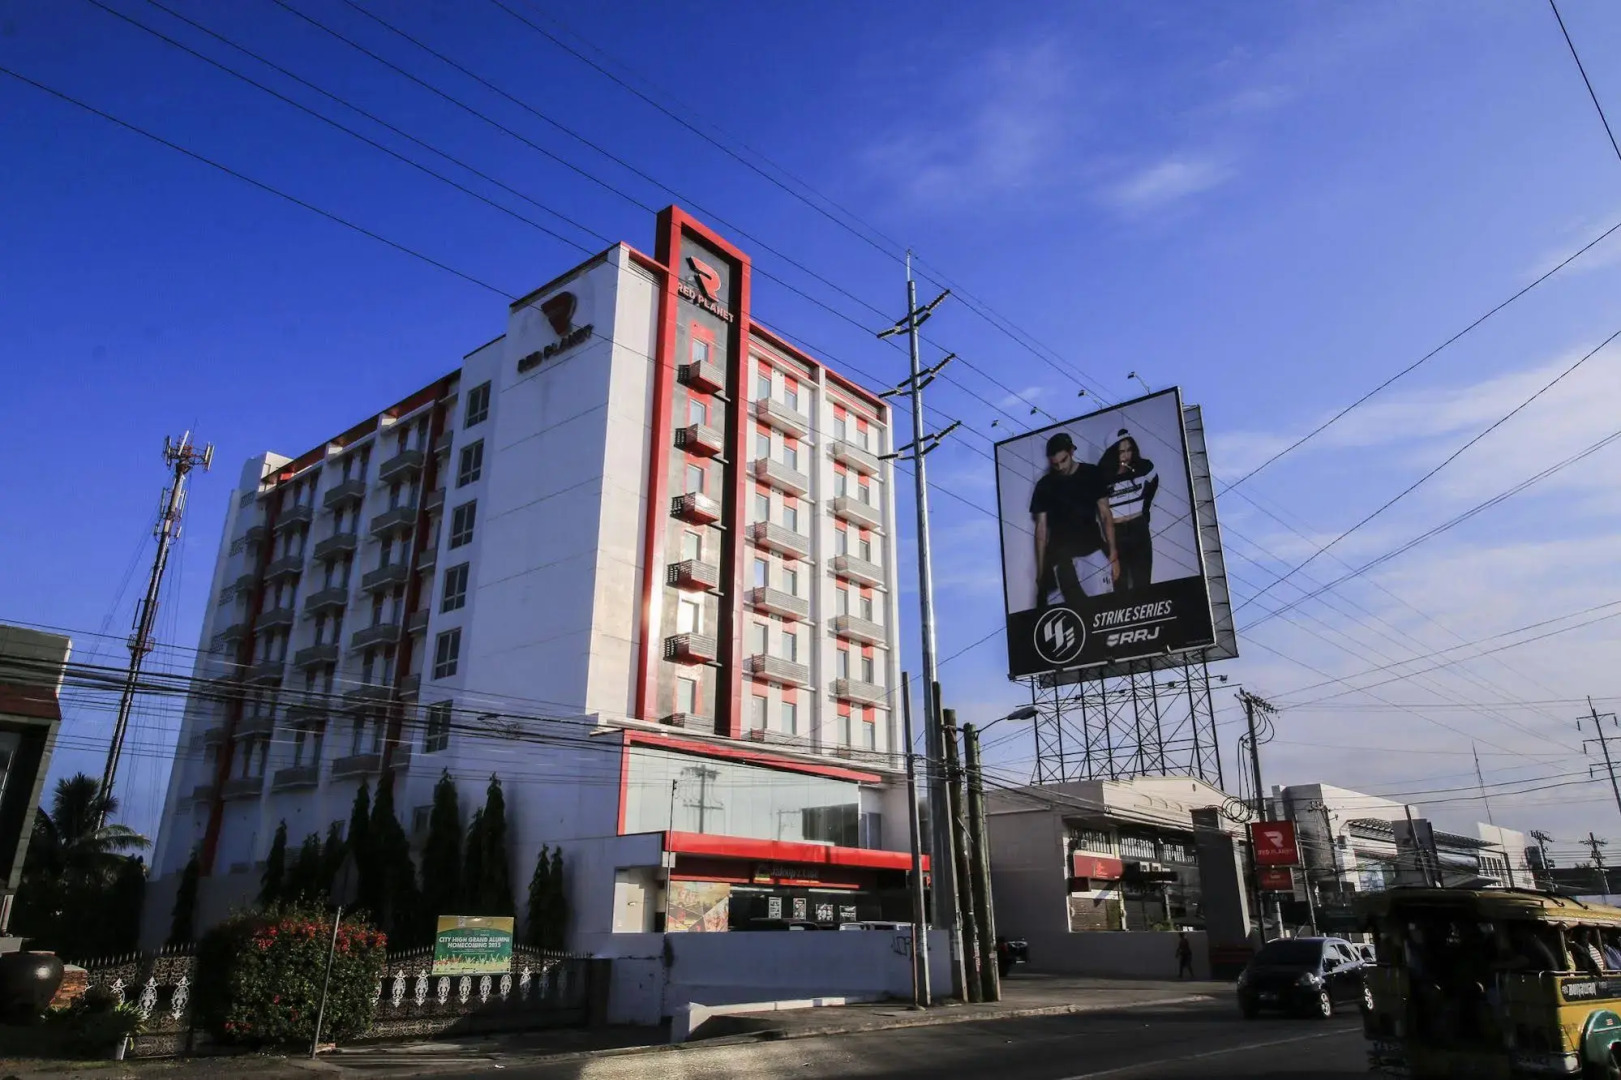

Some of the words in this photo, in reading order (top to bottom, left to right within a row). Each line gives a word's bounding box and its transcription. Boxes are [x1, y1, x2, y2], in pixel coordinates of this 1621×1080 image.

[678, 282, 696, 300] RED
[697, 294, 734, 323] PLANET
[1092, 611, 1133, 628] STRIKE
[1132, 600, 1173, 621] SERIES
[1119, 626, 1160, 645] RRJ
